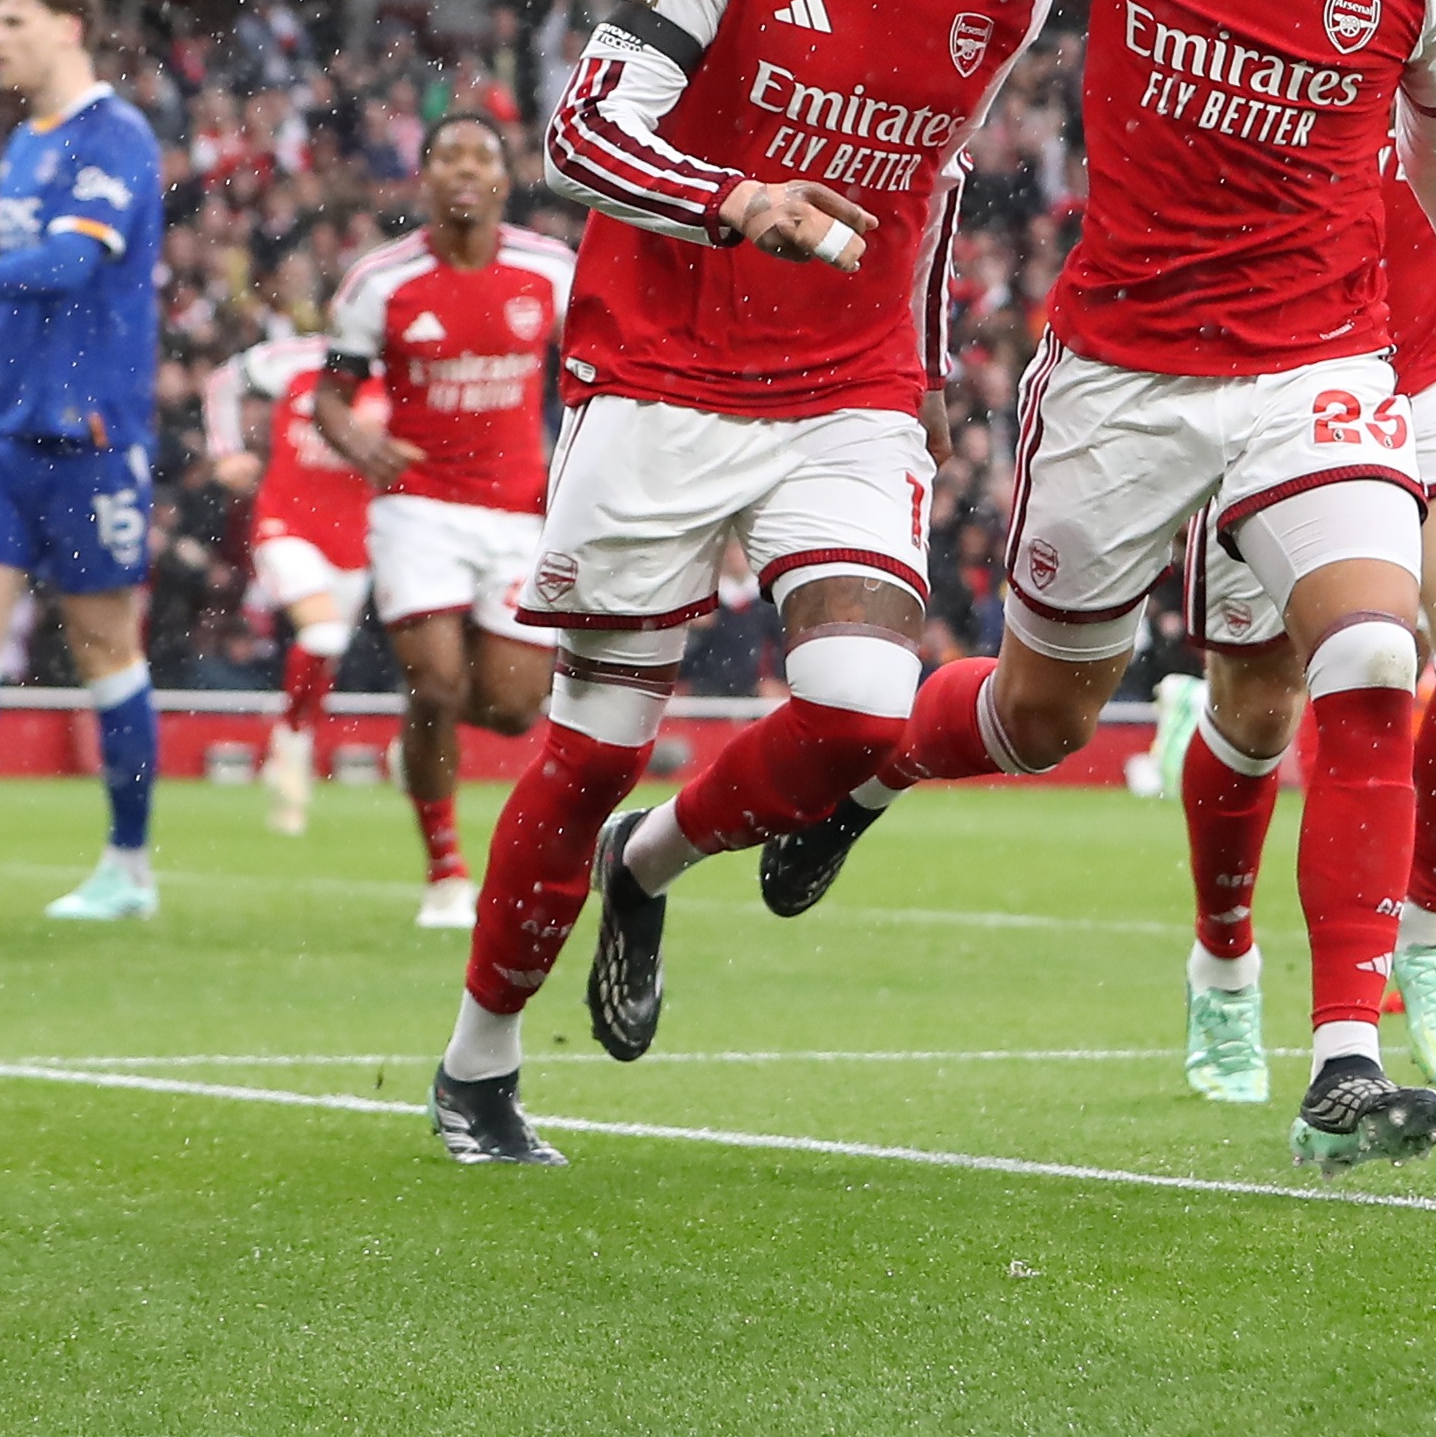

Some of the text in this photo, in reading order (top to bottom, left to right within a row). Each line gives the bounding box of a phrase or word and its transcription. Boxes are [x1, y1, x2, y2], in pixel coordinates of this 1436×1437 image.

[1125, 0, 1364, 107] Emirates
[749, 59, 965, 148] Emirates
[1141, 71, 1317, 148] FLY BETTER
[765, 125, 923, 192] FLY BETTER
